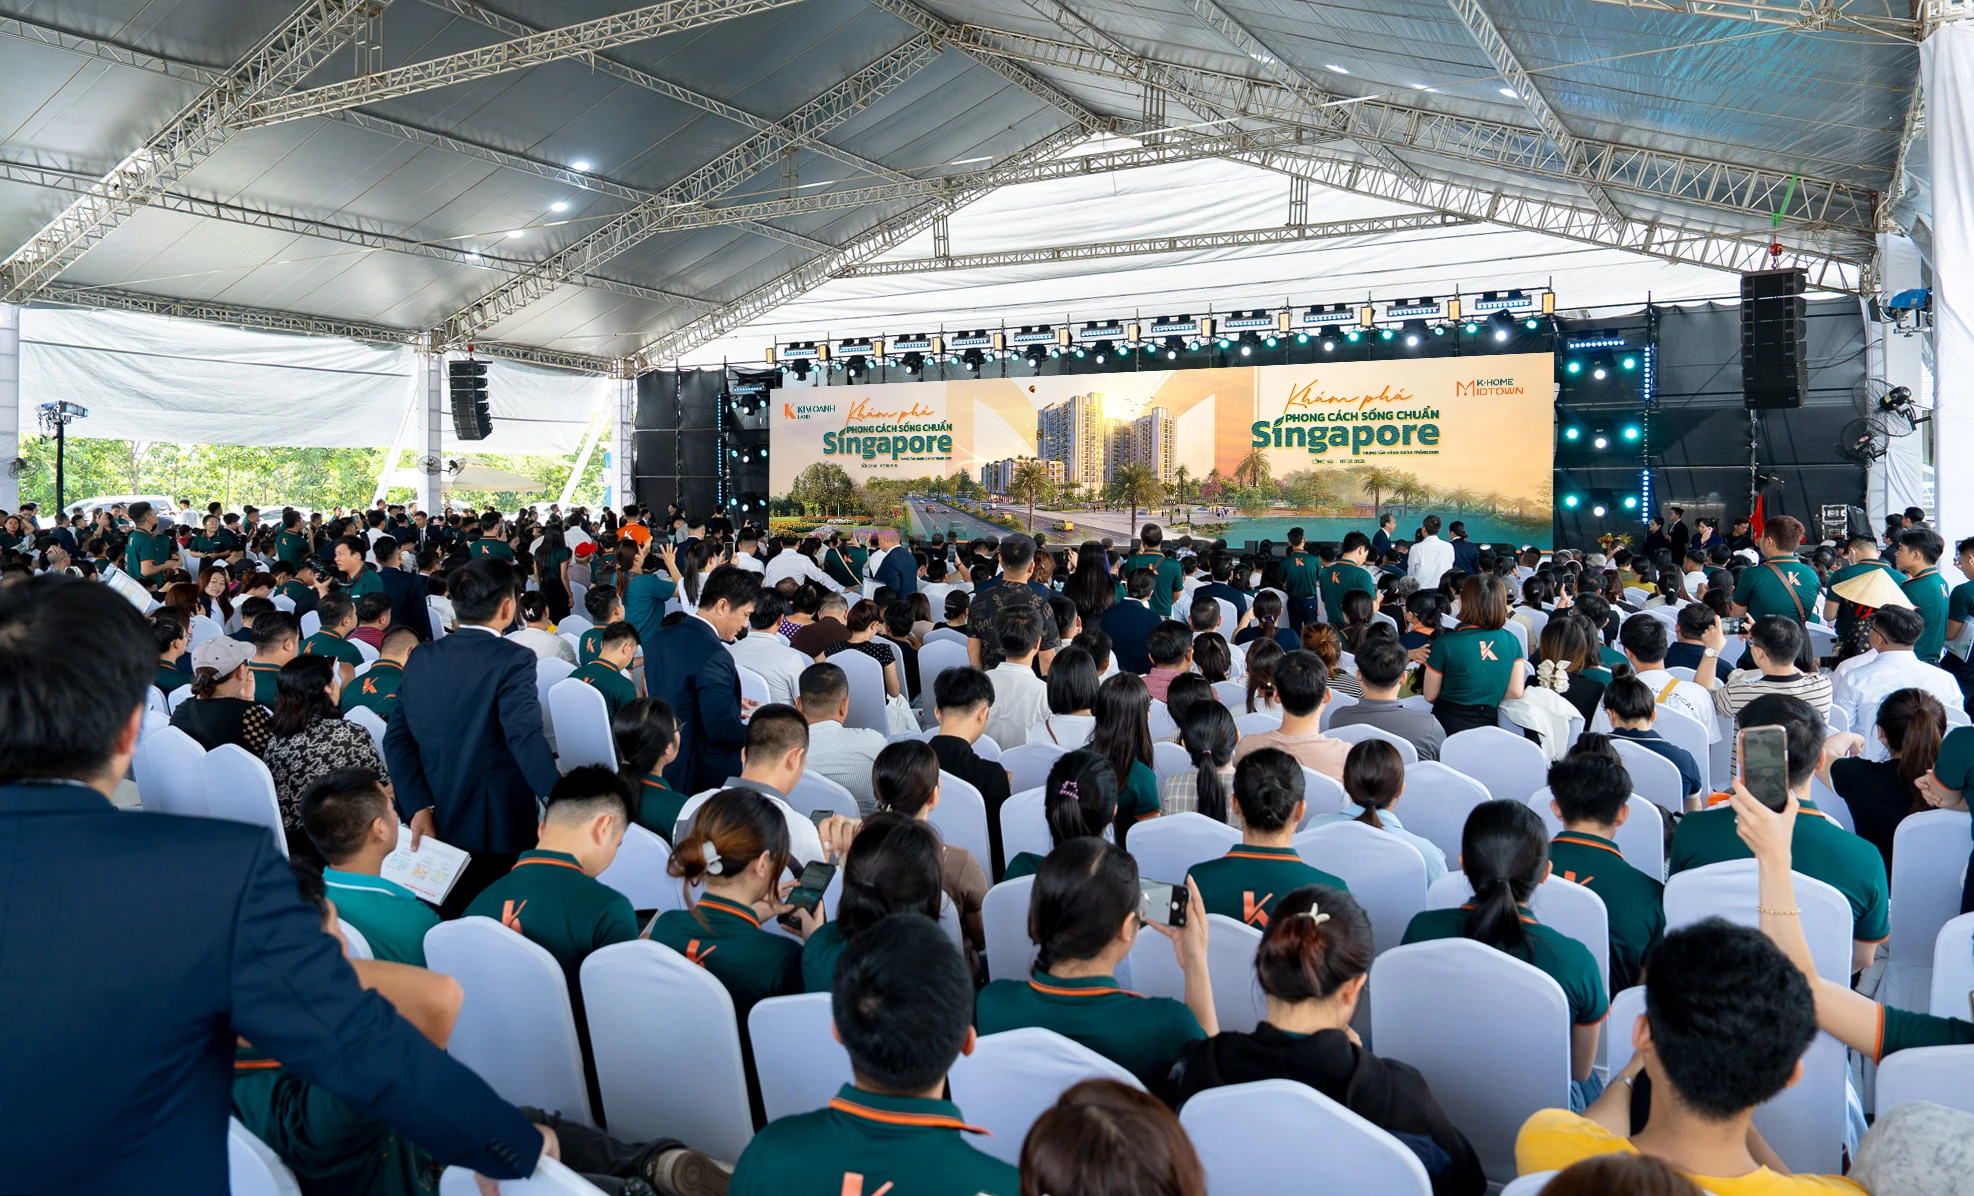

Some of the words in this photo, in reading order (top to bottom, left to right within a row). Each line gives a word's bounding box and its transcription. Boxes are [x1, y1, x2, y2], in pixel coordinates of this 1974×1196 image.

[1476, 378, 1514, 387] K-HOME
[1283, 379, 1359, 415] Khám
[1359, 384, 1413, 411] phá
[845, 397, 898, 426] Khám
[897, 402, 935, 424] phá
[1285, 412, 1325, 422] PHONG
[1327, 409, 1359, 422] CÁCH
[1362, 407, 1394, 421] SỐNG
[1396, 406, 1440, 420] CHUẨN
[846, 425, 875, 434] PHONG
[875, 422, 898, 433] CÁCH
[898, 421, 922, 432] SỐNG
[922, 419, 953, 431] CHUẨN
[1251, 416, 1440, 455] Singapore
[823, 428, 953, 461] Singapore
[1295, 557, 1305, 567] K
[1331, 571, 1340, 584] K
[1788, 571, 1802, 586] K
[587, 637, 597, 653] K
[1479, 640, 1499, 661] K
[362, 677, 379, 695] K
[1651, 687, 1692, 708] NTICA
[501, 899, 528, 935] K
[1243, 891, 1274, 929] K
